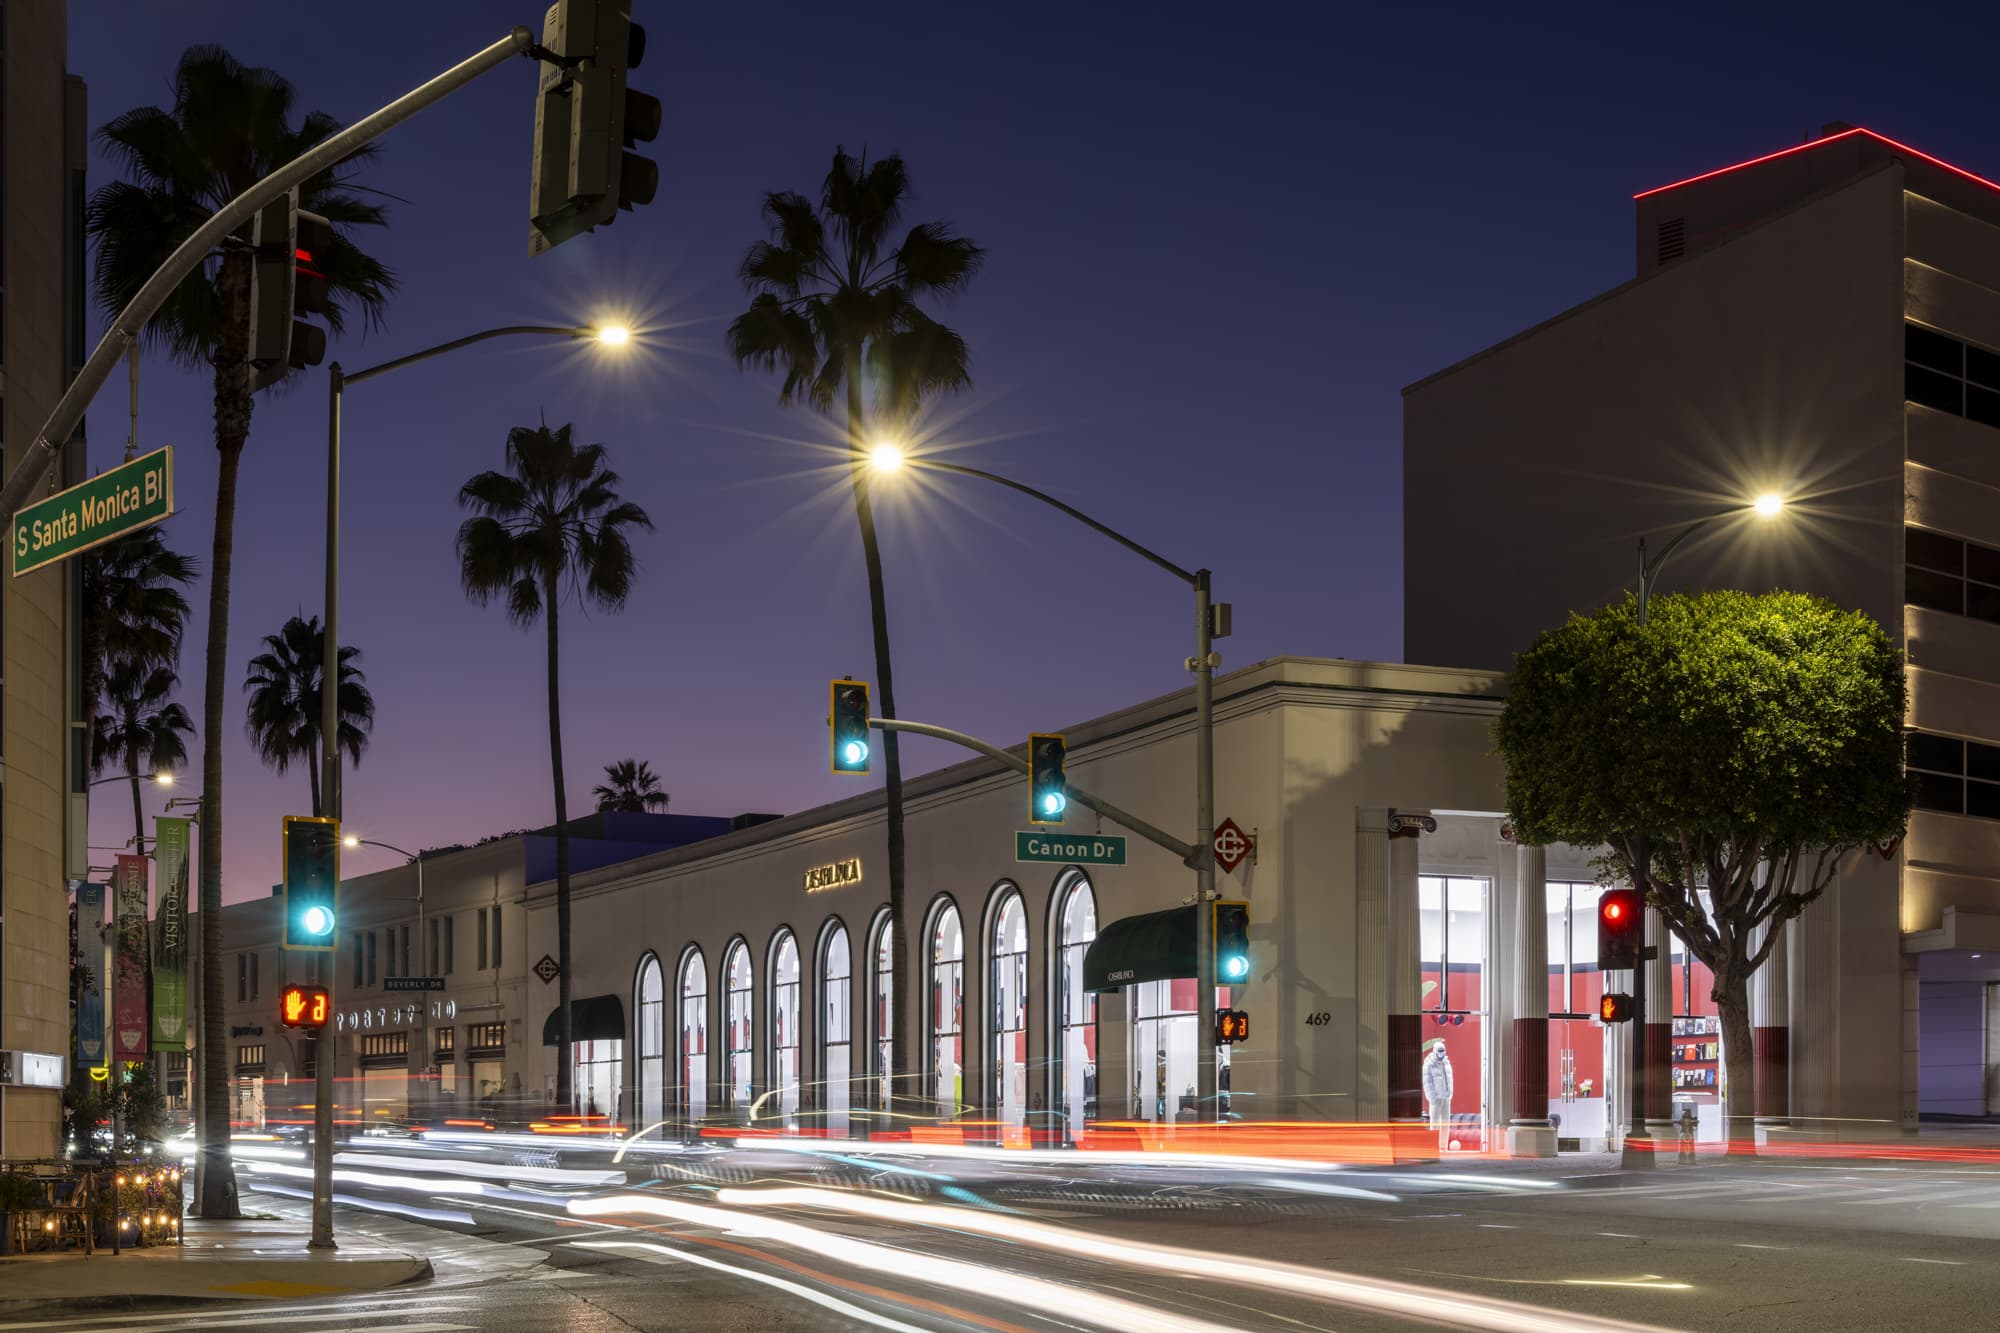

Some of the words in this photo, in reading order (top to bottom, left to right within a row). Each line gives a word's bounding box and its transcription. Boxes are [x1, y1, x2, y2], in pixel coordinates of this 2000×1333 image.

[18, 525, 28, 557] S
[32, 508, 77, 551] Santa
[82, 485, 140, 532] Monica
[145, 467, 163, 505] Bl
[1028, 839, 1088, 857] Canon
[1093, 842, 1115, 858] Dr
[387, 980, 425, 988] BEVERLY
[1305, 1012, 1331, 1026] 469
